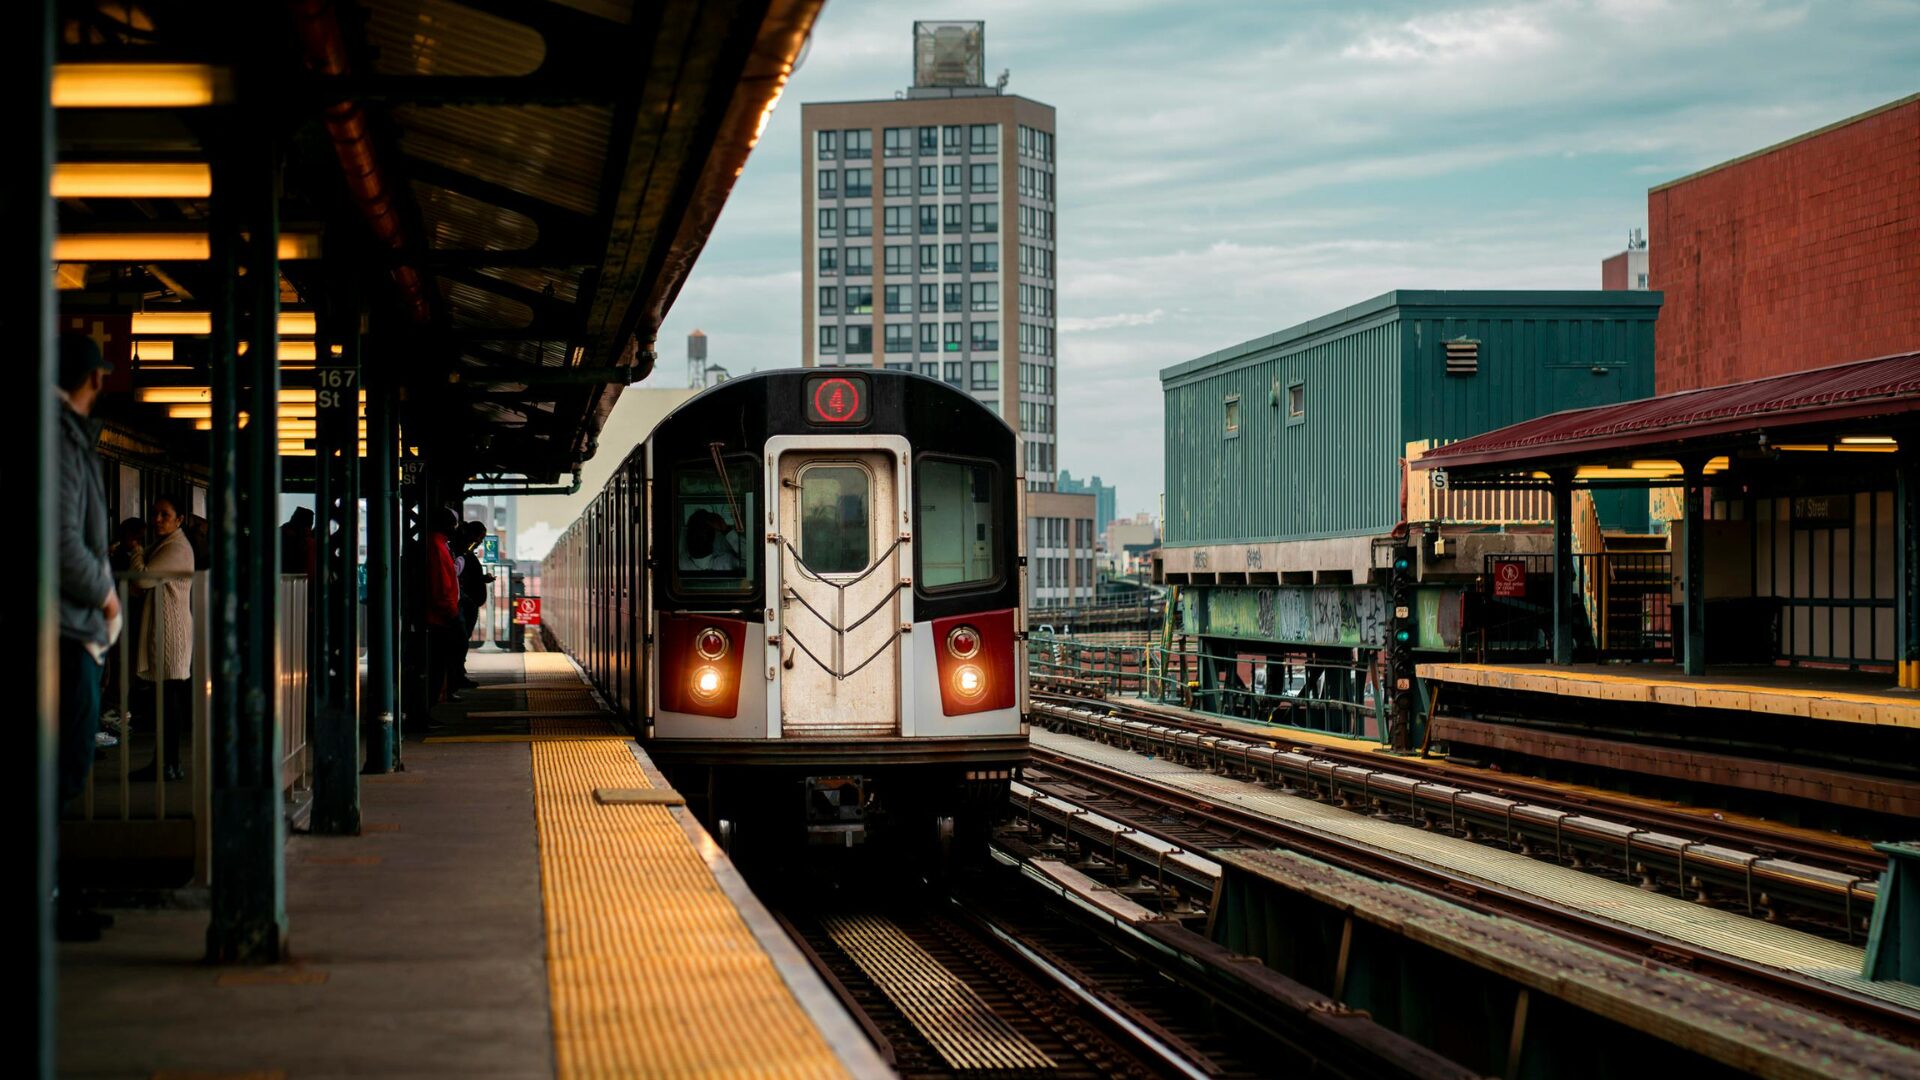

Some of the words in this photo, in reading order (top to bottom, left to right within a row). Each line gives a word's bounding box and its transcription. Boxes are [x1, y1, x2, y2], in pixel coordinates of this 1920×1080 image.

[319, 370, 356, 388] 167
[318, 390, 341, 408] St
[829, 387, 845, 413] 4
[403, 462, 425, 473] 167
[403, 474, 416, 485] St
[1434, 474, 1445, 488] S
